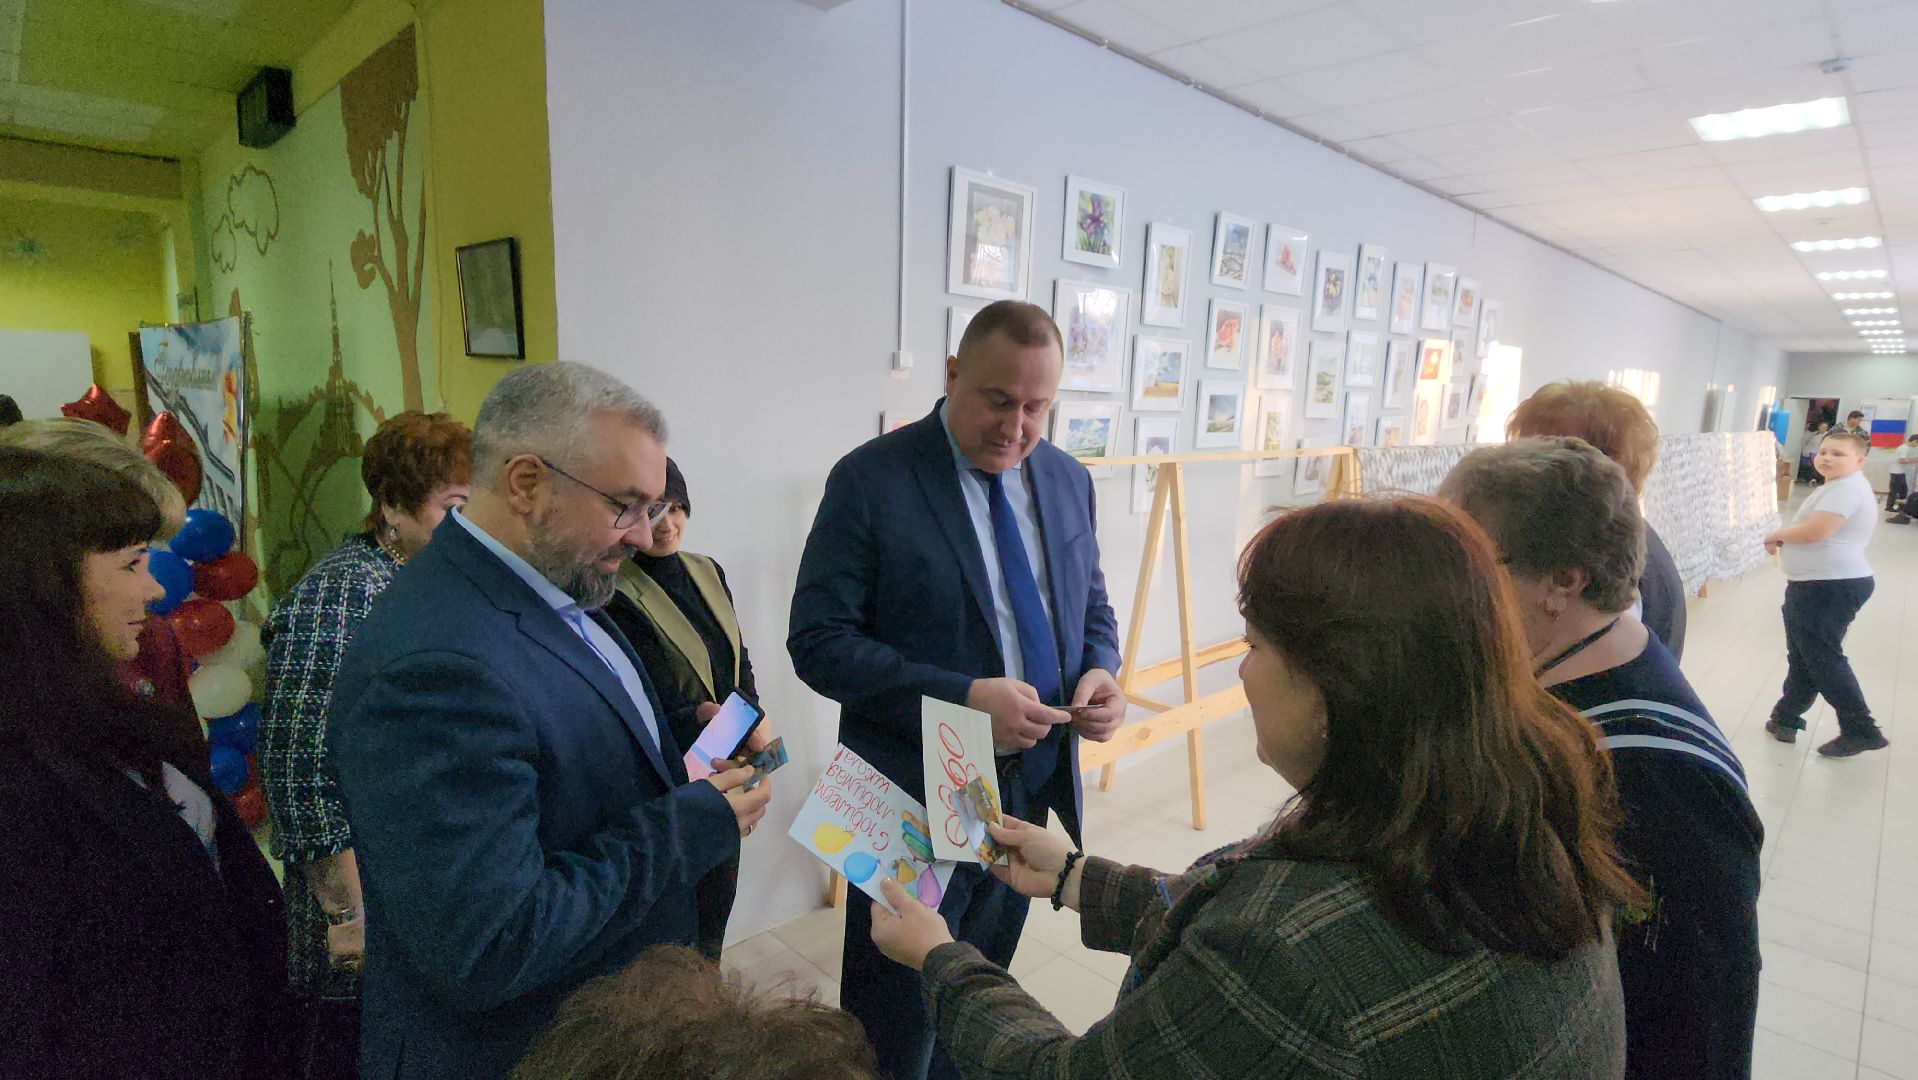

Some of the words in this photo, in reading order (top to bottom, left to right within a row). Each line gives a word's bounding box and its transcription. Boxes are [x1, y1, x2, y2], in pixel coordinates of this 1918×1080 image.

[826, 762, 895, 819] любимая
[834, 747, 890, 794] школа!
[872, 831, 889, 851] С
